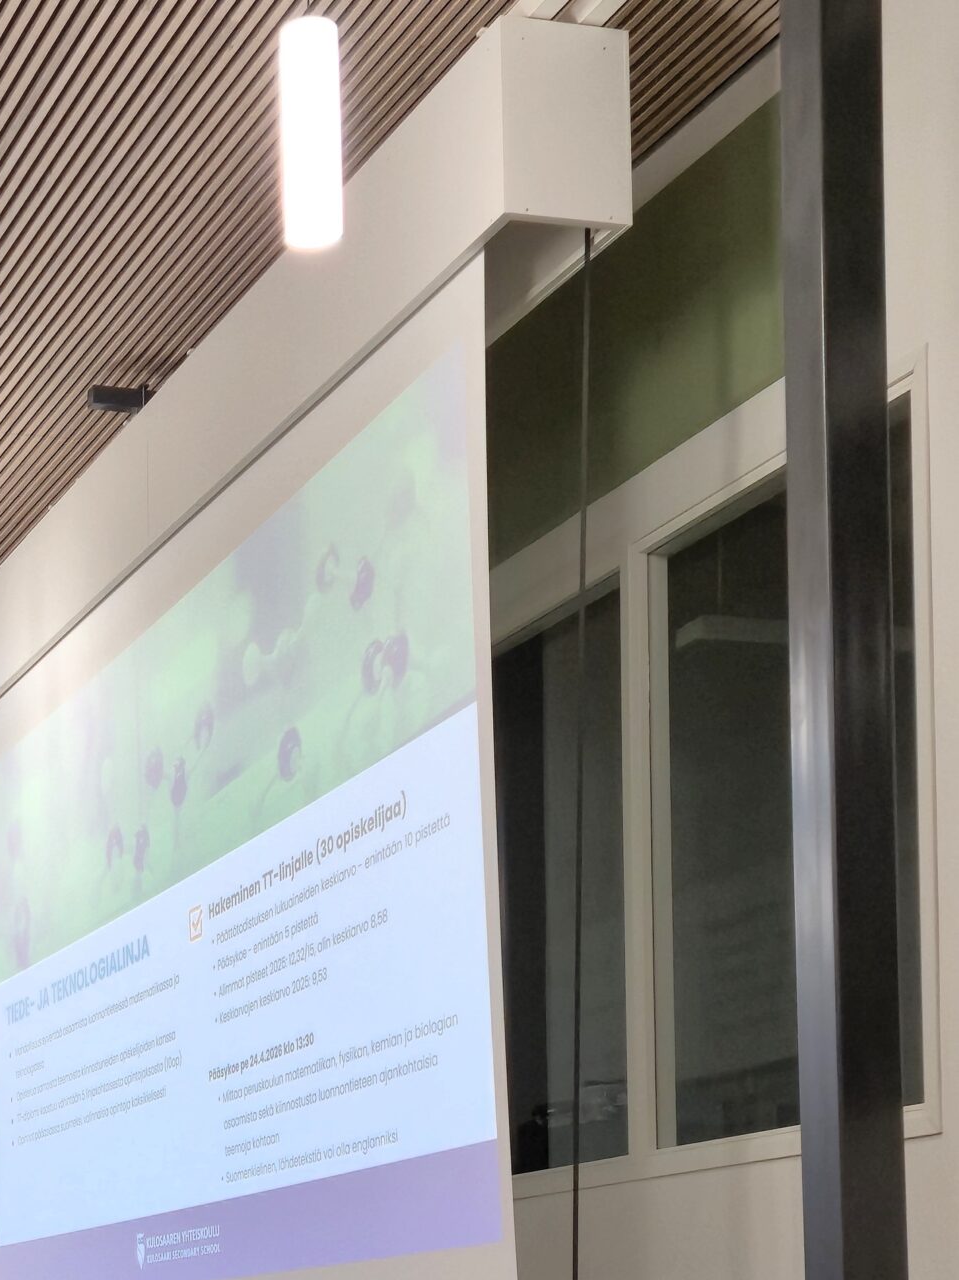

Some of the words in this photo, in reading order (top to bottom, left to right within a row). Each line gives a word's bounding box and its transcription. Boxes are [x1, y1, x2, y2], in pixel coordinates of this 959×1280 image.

[208, 880, 261, 920] Hakeminen
[262, 849, 314, 890] TT-linjalle
[316, 835, 334, 865] (30
[335, 790, 407, 852] opiskelijaa)
[216, 907, 274, 945] Päättötodistuksen
[274, 883, 320, 916] lukuaineiden
[321, 864, 357, 891] keskiarvo
[364, 840, 403, 869] enintään
[404, 831, 413, 848] 10
[414, 812, 451, 848] pistettä
[217, 948, 248, 971] Pääsykoe
[252, 930, 284, 954] enintään
[284, 924, 290, 939] 5
[290, 911, 319, 939] pistettä
[245, 965, 269, 989] pisteet
[332, 920, 369, 945] keskiarvo
[6, 996, 35, 1026] TIEDE-
[37, 987, 50, 1011] JA
[51, 934, 151, 1004] TEKNOLOGIALINJA
[259, 985, 291, 1008] keskiarvo
[208, 1062, 240, 1081] Pääsykoe
[240, 1059, 249, 1075] pe
[249, 1043, 283, 1068] 24.4.2026
[283, 1040, 295, 1056] klo
[295, 1032, 315, 1051] 13:30
[222, 1088, 243, 1103] Mittaa
[243, 1074, 284, 1100] peruskoulun
[370, 1033, 403, 1054] kemian
[404, 1028, 413, 1048] ja
[414, 1014, 459, 1039] biologian
[223, 1111, 258, 1130] osaamista
[258, 1103, 275, 1120] sekä
[275, 1092, 318, 1114] kiinnostusta
[318, 1073, 378, 1102] luonnontieteen
[379, 1053, 438, 1086] ajankohtaisia
[224, 1139, 252, 1157] teemoja
[252, 1132, 280, 1149] kohtaan
[351, 1130, 399, 1156] englanniksi
[146, 1231, 181, 1249] KULOSAAREN
[181, 1224, 220, 1243] YHTEISKOULU
